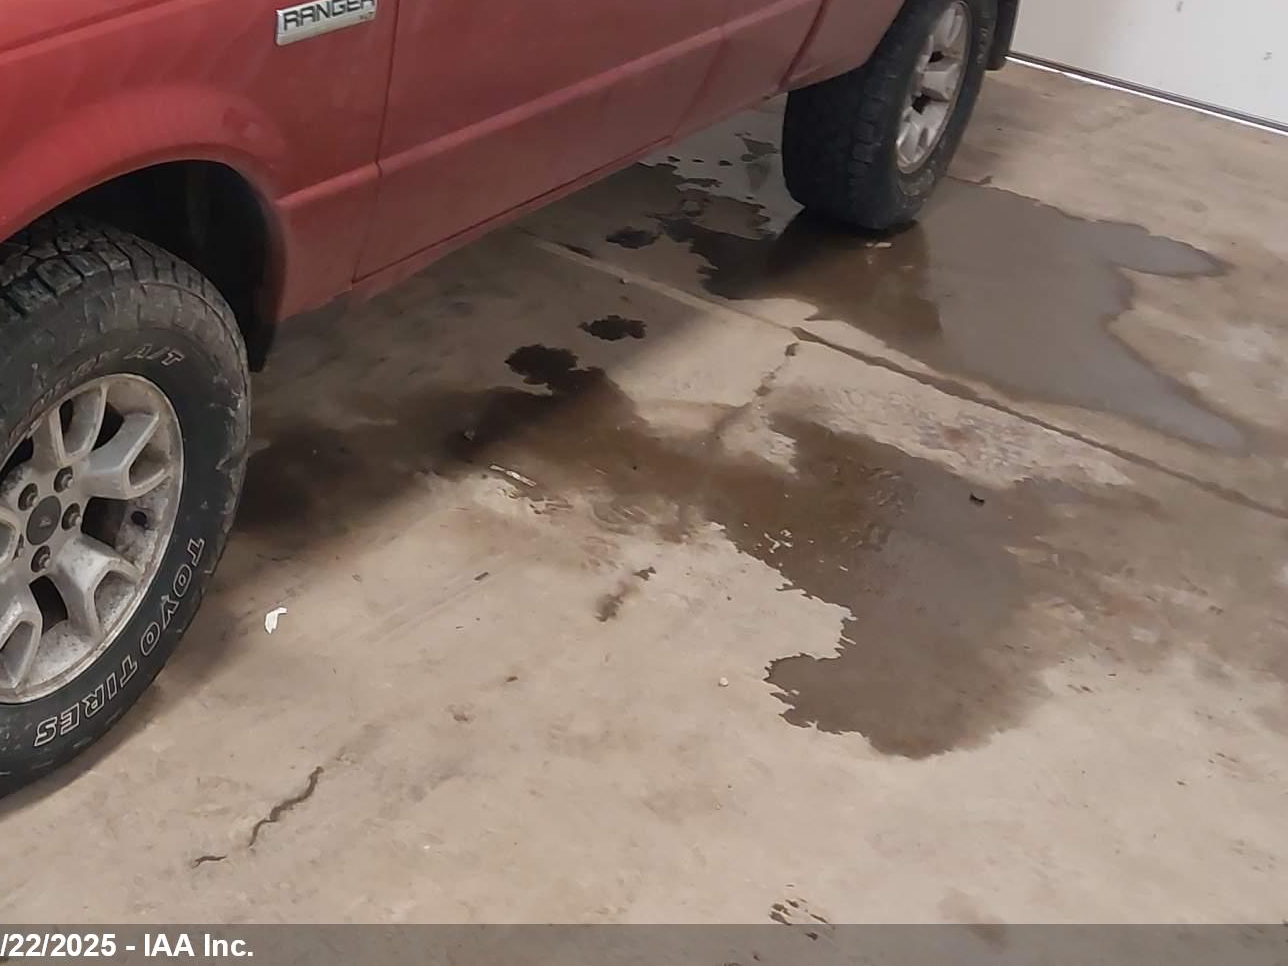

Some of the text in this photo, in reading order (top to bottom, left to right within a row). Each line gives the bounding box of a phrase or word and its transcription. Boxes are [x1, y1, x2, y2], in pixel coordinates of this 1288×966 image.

[122, 343, 185, 366] A/T
[34, 537, 205, 747] TOYO TIRES
